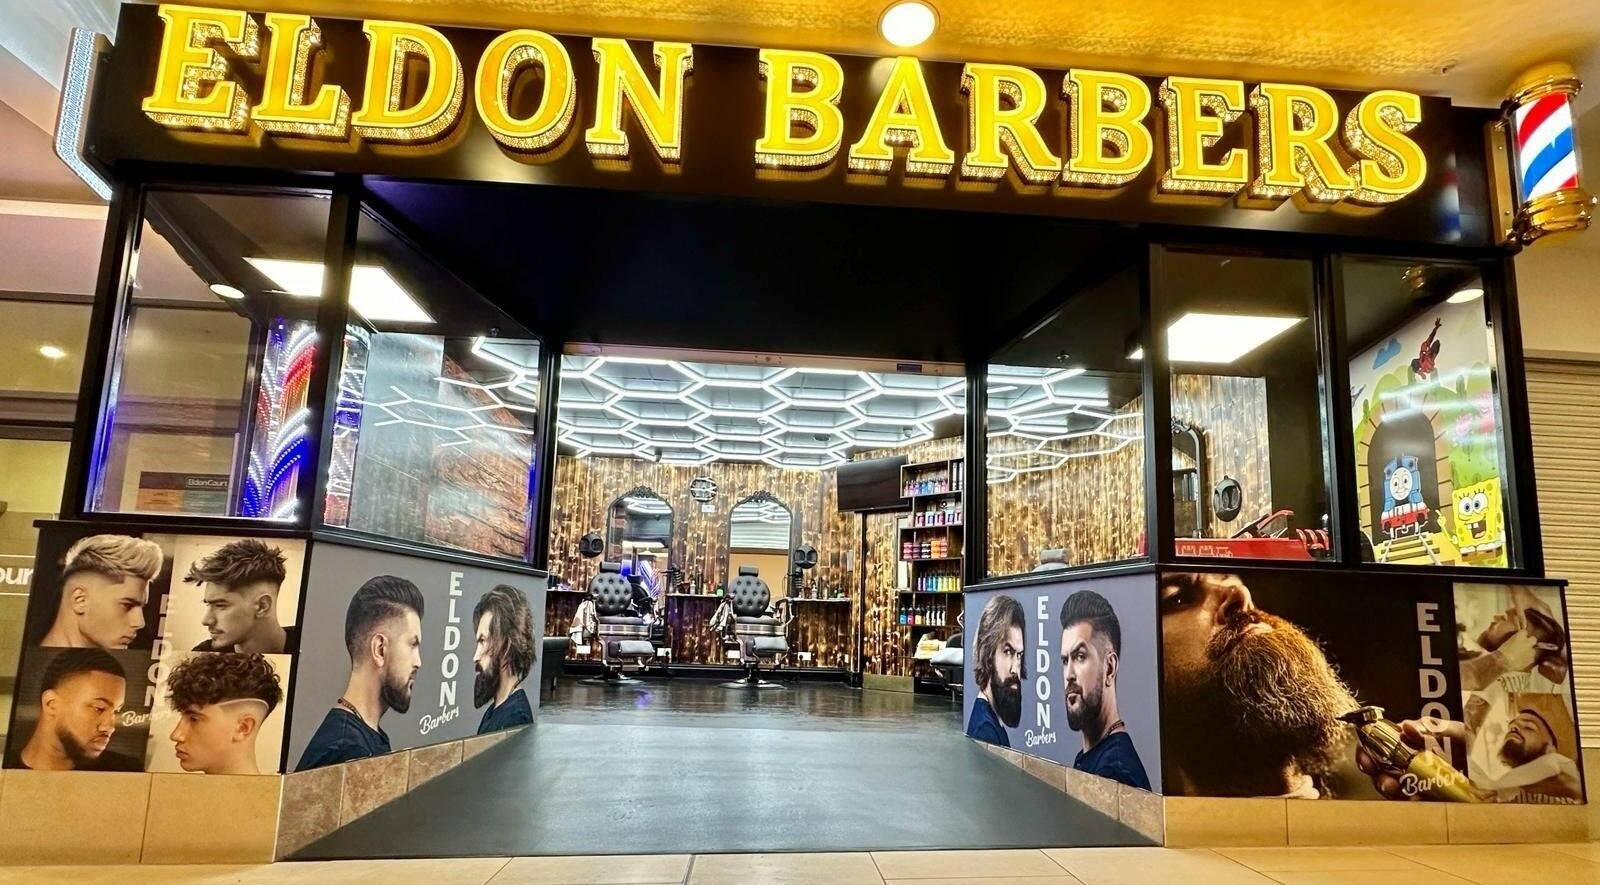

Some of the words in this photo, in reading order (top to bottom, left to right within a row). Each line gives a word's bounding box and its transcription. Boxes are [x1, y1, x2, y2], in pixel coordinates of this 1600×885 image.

[142, 3, 693, 160] ELDON
[754, 47, 1428, 203] BARBERS
[143, 594, 177, 708] ELDON
[439, 571, 464, 707] ELDON
[1036, 595, 1051, 729] ELDON
[1416, 602, 1453, 766] ELDON
[419, 705, 460, 736] Barbers
[1025, 726, 1057, 748] Barbers
[1399, 767, 1469, 797] Barbers
